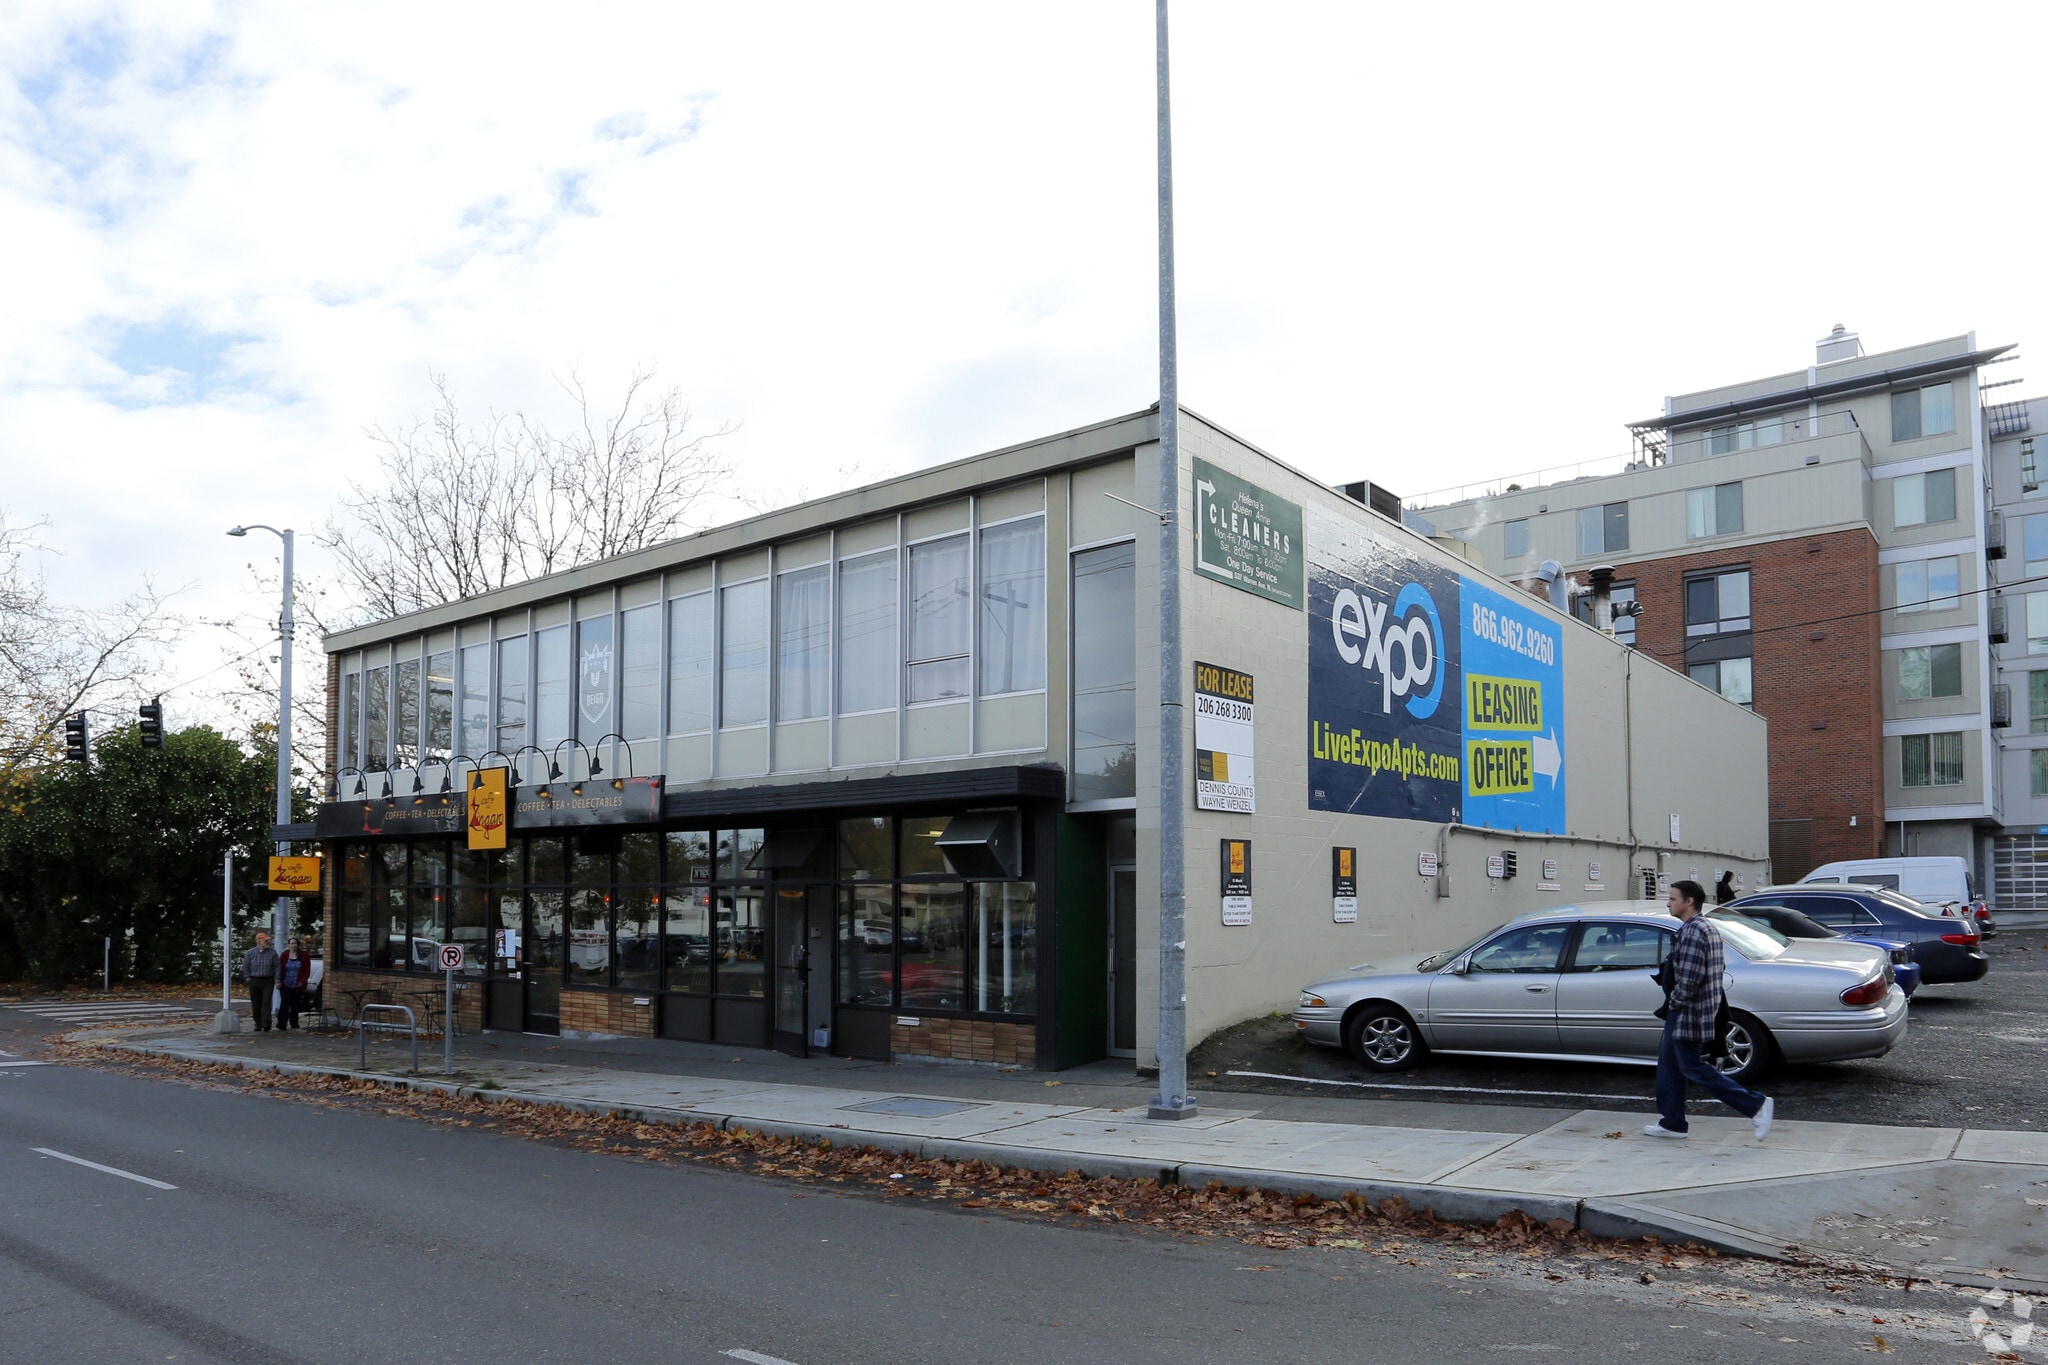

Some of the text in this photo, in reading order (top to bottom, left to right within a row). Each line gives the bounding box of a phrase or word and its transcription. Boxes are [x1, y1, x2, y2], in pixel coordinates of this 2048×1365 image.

[1231, 500, 1271, 526] Queen Anne
[1238, 491, 1264, 511] Helena's
[1209, 503, 1290, 554] CLEANERS
[1256, 554, 1262, 565] To
[1261, 545, 1269, 556] To
[1227, 557, 1278, 584] One Day Service
[1472, 602, 1555, 666] 866.962.9260
[1332, 586, 1434, 714] expo
[1197, 665, 1253, 700] FOR LEASE
[586, 692, 604, 706] REIGN
[1198, 697, 1252, 722] 206 268 3300
[1472, 681, 1539, 725] LEASING
[1313, 720, 1459, 782] LiveExpoApts.com
[1473, 746, 1529, 789] OFFICE
[1199, 781, 1253, 798] DENNIS COUNTS
[385, 809, 407, 820] COFFEE
[411, 809, 422, 819] TEA
[517, 796, 623, 813] COFFEE TEA DELECTABLES
[1202, 796, 1252, 811] WAYNE WENZEL
[469, 804, 504, 840] Zingaro
[274, 868, 312, 889] Zingaro
